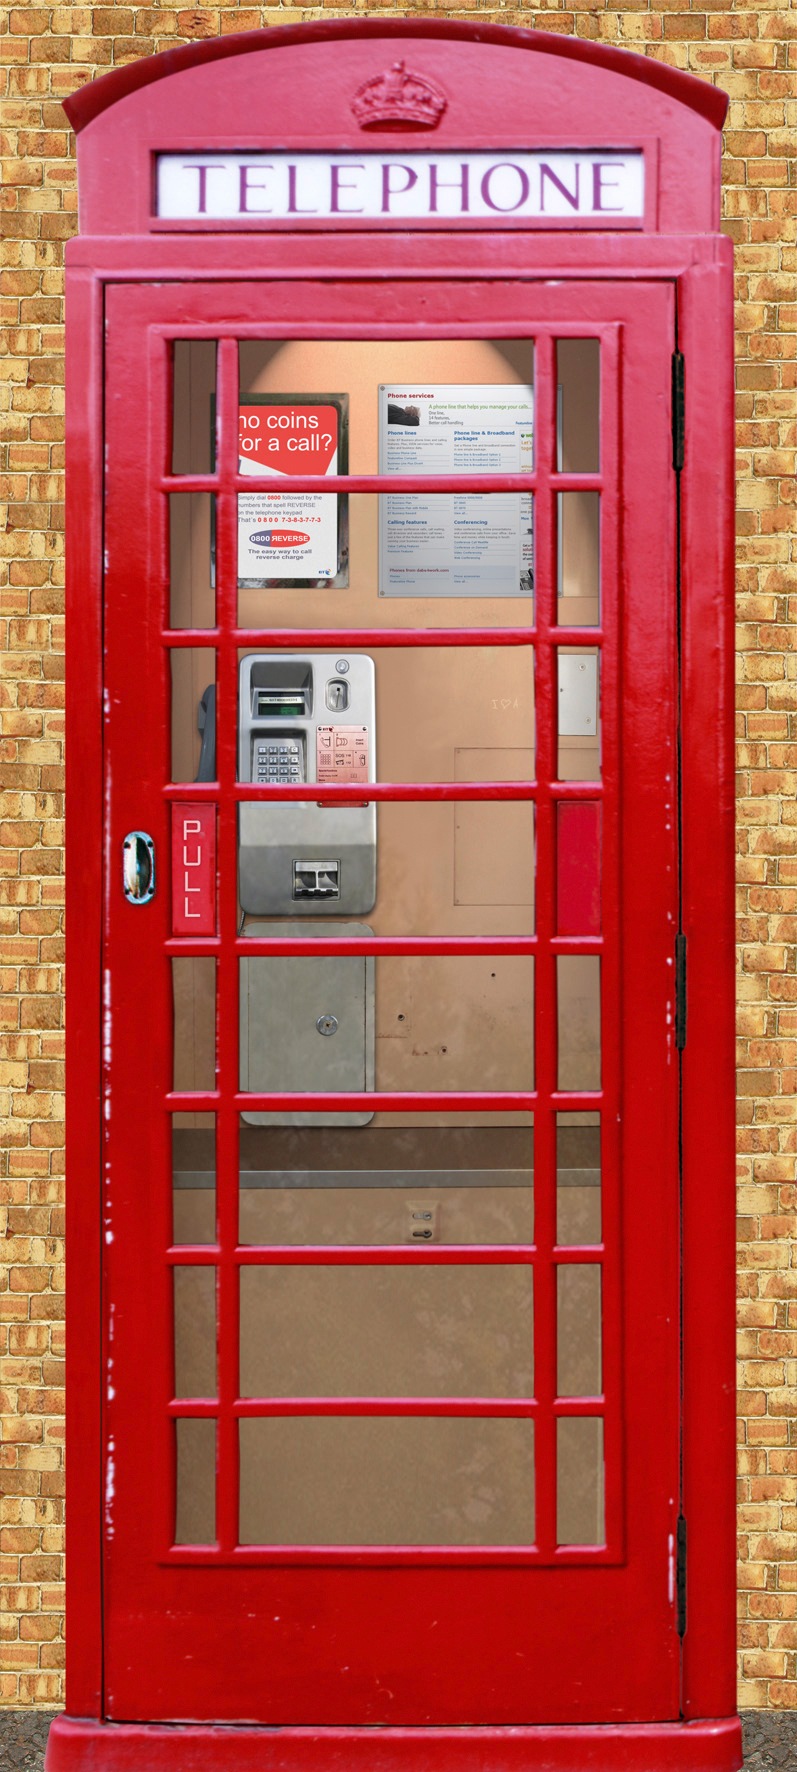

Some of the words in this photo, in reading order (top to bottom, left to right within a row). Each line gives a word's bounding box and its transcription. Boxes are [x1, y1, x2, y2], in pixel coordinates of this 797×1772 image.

[183, 162, 626, 214] TELEPHONE
[267, 412, 318, 428] coins
[268, 438, 279, 451] a
[287, 434, 332, 451] call?
[184, 820, 201, 917] PULL
